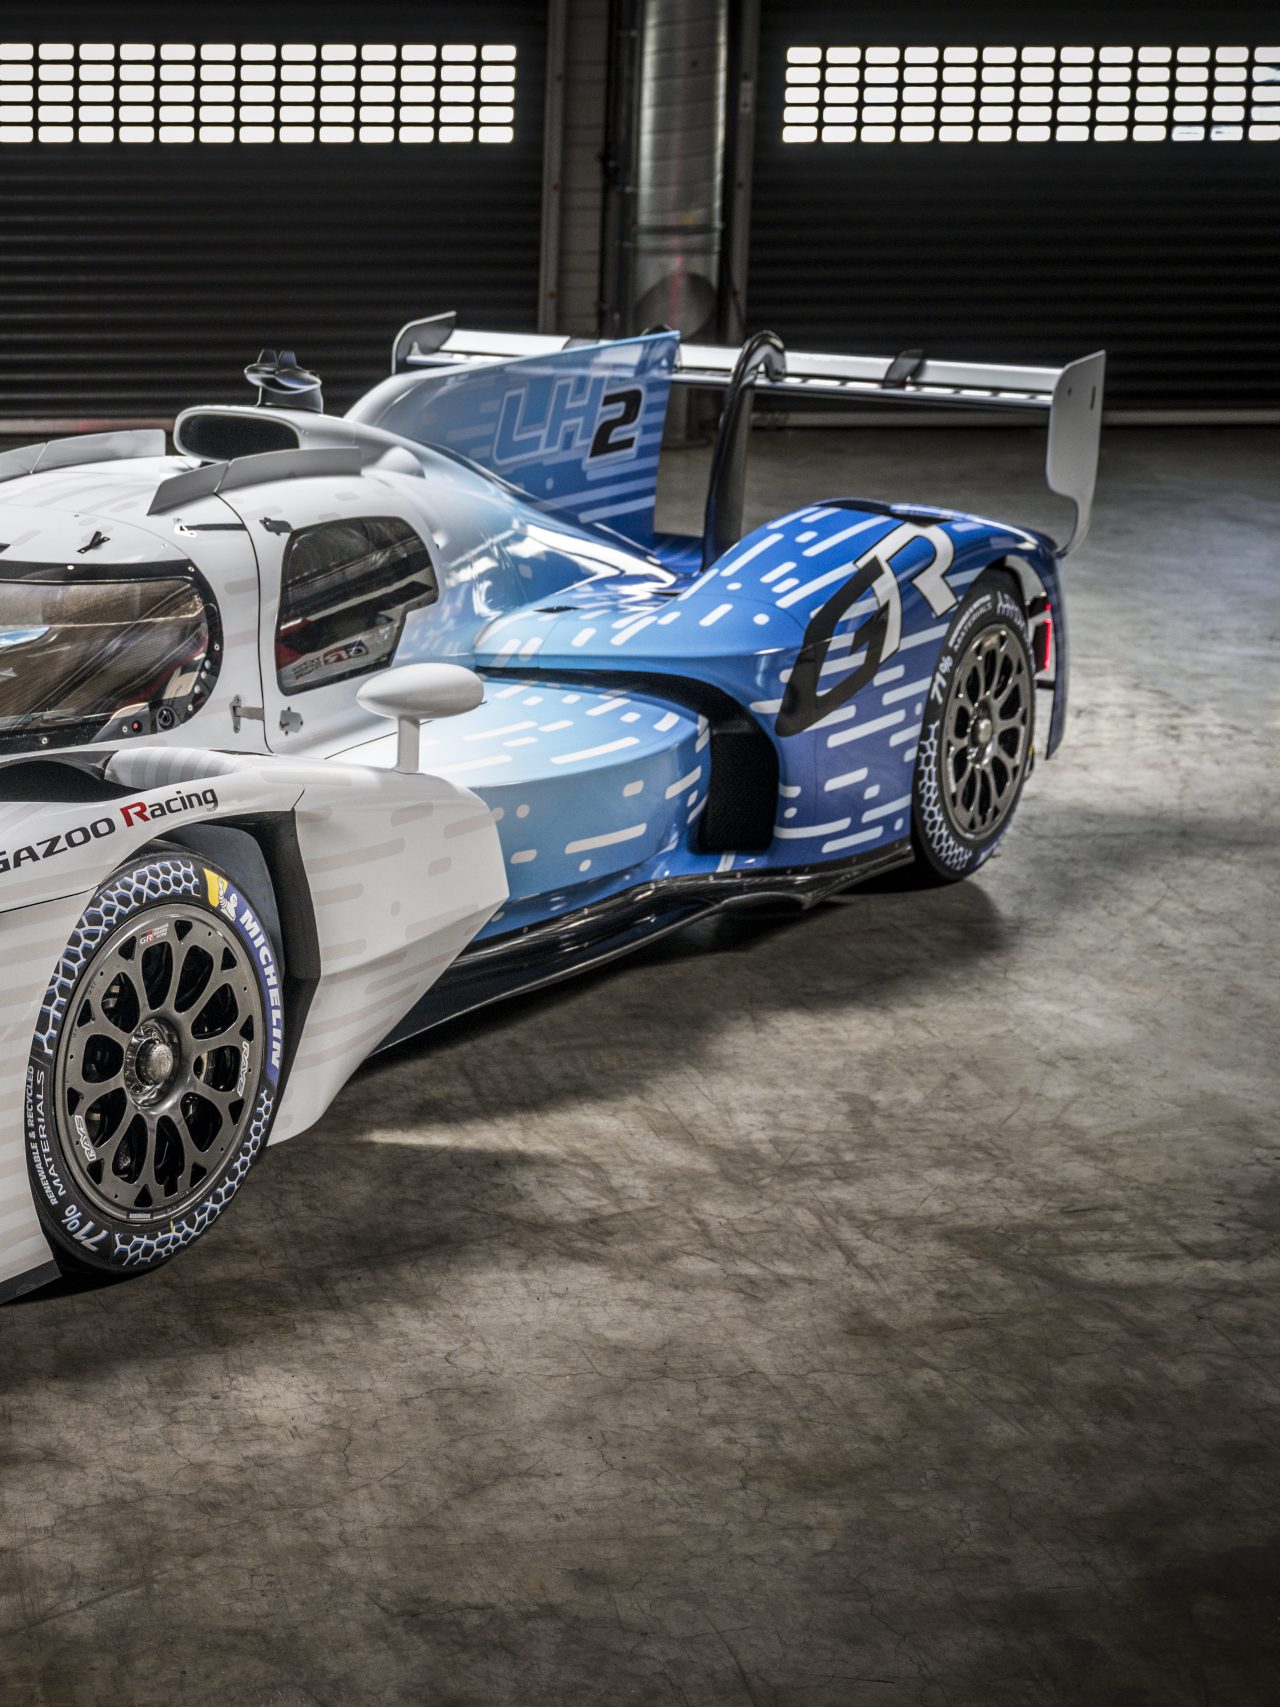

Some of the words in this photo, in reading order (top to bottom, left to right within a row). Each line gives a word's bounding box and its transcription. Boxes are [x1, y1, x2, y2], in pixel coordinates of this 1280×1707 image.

[492, 374, 645, 467] LH2
[774, 521, 961, 737] GR
[120, 788, 218, 828] Racing
[239, 909, 283, 1069] MICHELIN
[26, 1065, 35, 1129] RECYCLED
[237, 1041, 250, 1097] RAYS
[28, 1131, 36, 1139] &
[36, 1070, 67, 1197] MATERIALS
[74, 1114, 97, 1162] RAYS
[28, 1142, 59, 1206] RENEWABLE
[61, 1204, 109, 1252] 71%
